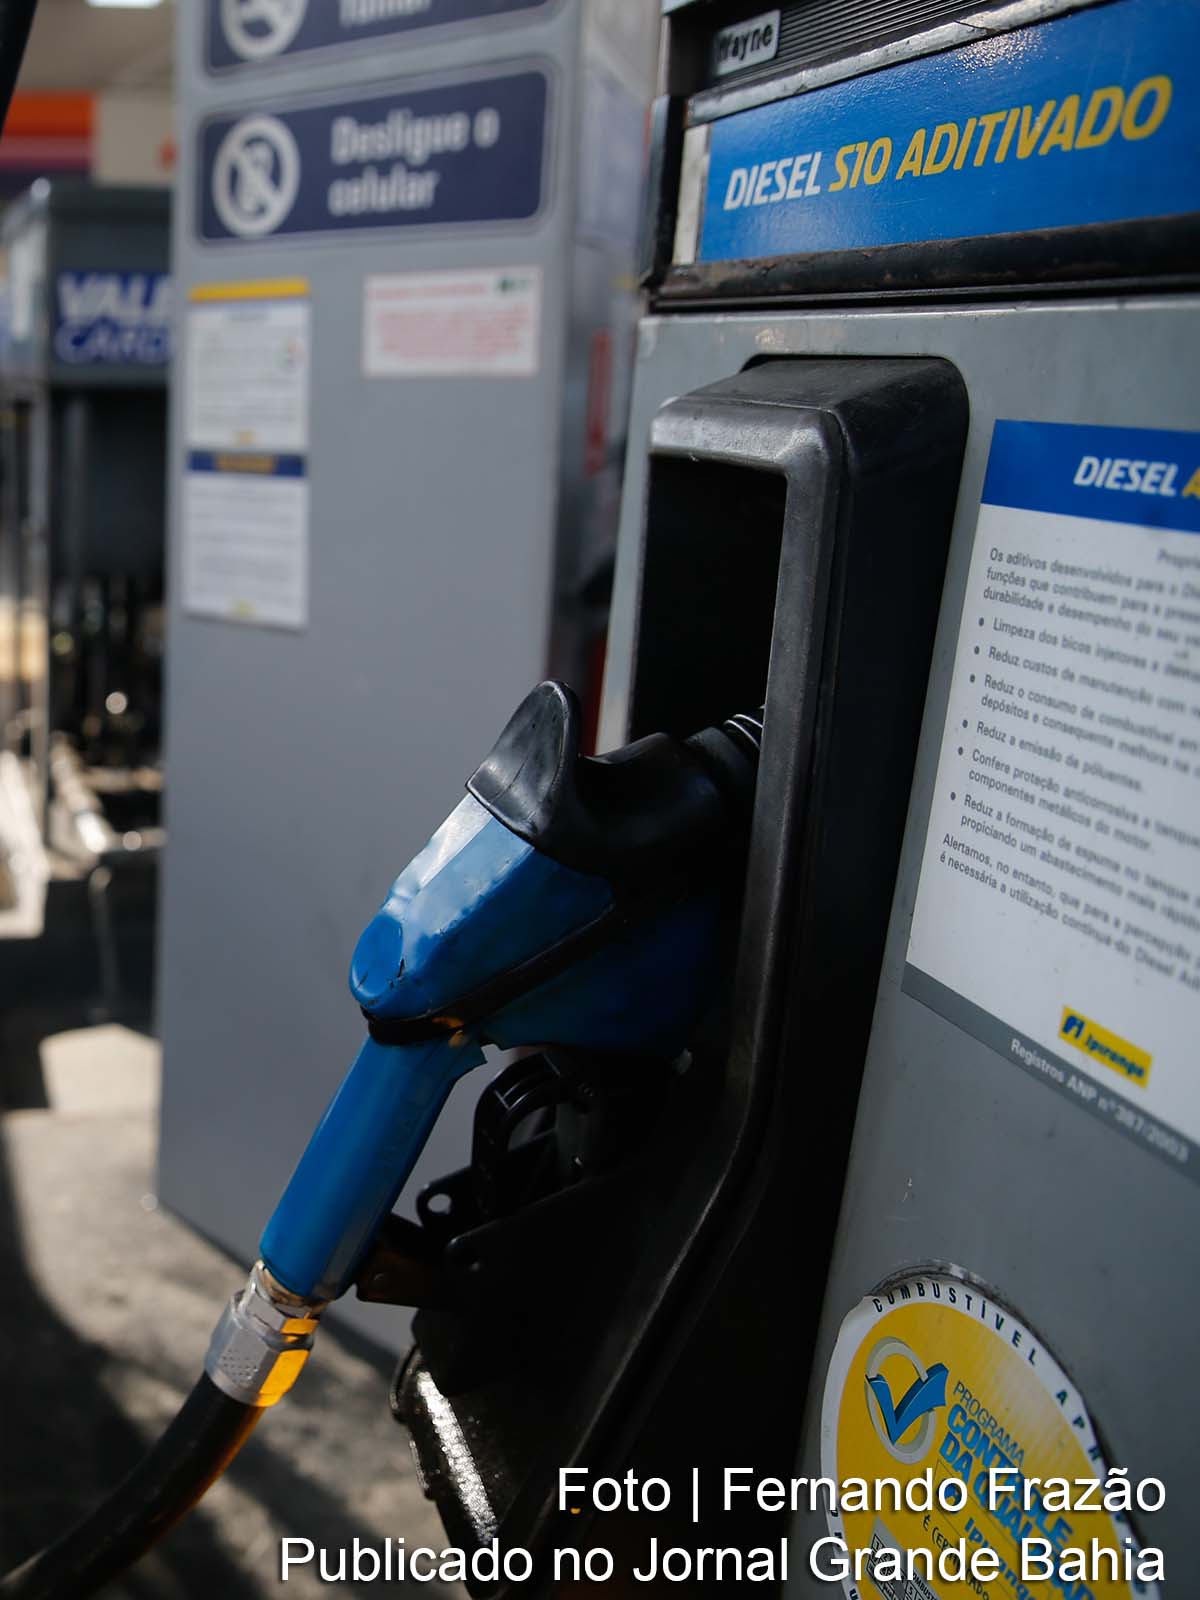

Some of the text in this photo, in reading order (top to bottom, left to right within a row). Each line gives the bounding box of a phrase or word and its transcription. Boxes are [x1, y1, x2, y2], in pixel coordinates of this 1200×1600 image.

[715, 24, 773, 63] Wayne
[330, 107, 501, 166] Desligue o
[723, 74, 1173, 211] DIESEL S10 ADITIVADO
[327, 163, 440, 217] celular
[1073, 456, 1178, 497] DIESEL
[987, 567, 1026, 588] funções
[1029, 578, 1049, 593] que
[990, 548, 1003, 562] Os
[1006, 551, 1046, 571] aditivos
[983, 586, 1044, 612] durabilidade
[993, 617, 1036, 642] Limpeza
[1039, 628, 1058, 646] dos
[988, 646, 1019, 668] Reduz
[1022, 656, 1058, 678] custos
[981, 694, 1029, 721] depósitos
[984, 674, 1015, 698] Reduz
[1028, 690, 1077, 715] consumo
[976, 721, 1006, 743] Reduz
[1019, 737, 1062, 763] emissão
[969, 768, 1036, 807] componentes
[972, 748, 1011, 774] Confere
[1013, 766, 1061, 794] proteção
[961, 815, 1017, 850] propiciando
[1020, 841, 1038, 860] um
[964, 794, 994, 819] Reduz
[1005, 811, 1055, 844] formação
[940, 851, 946, 864] é
[948, 857, 998, 890] necessária
[1009, 886, 1058, 919] utilização
[996, 860, 1010, 876] no
[953, 1381, 1025, 1467] PROGRAMA
[941, 1432, 974, 1486] DA
